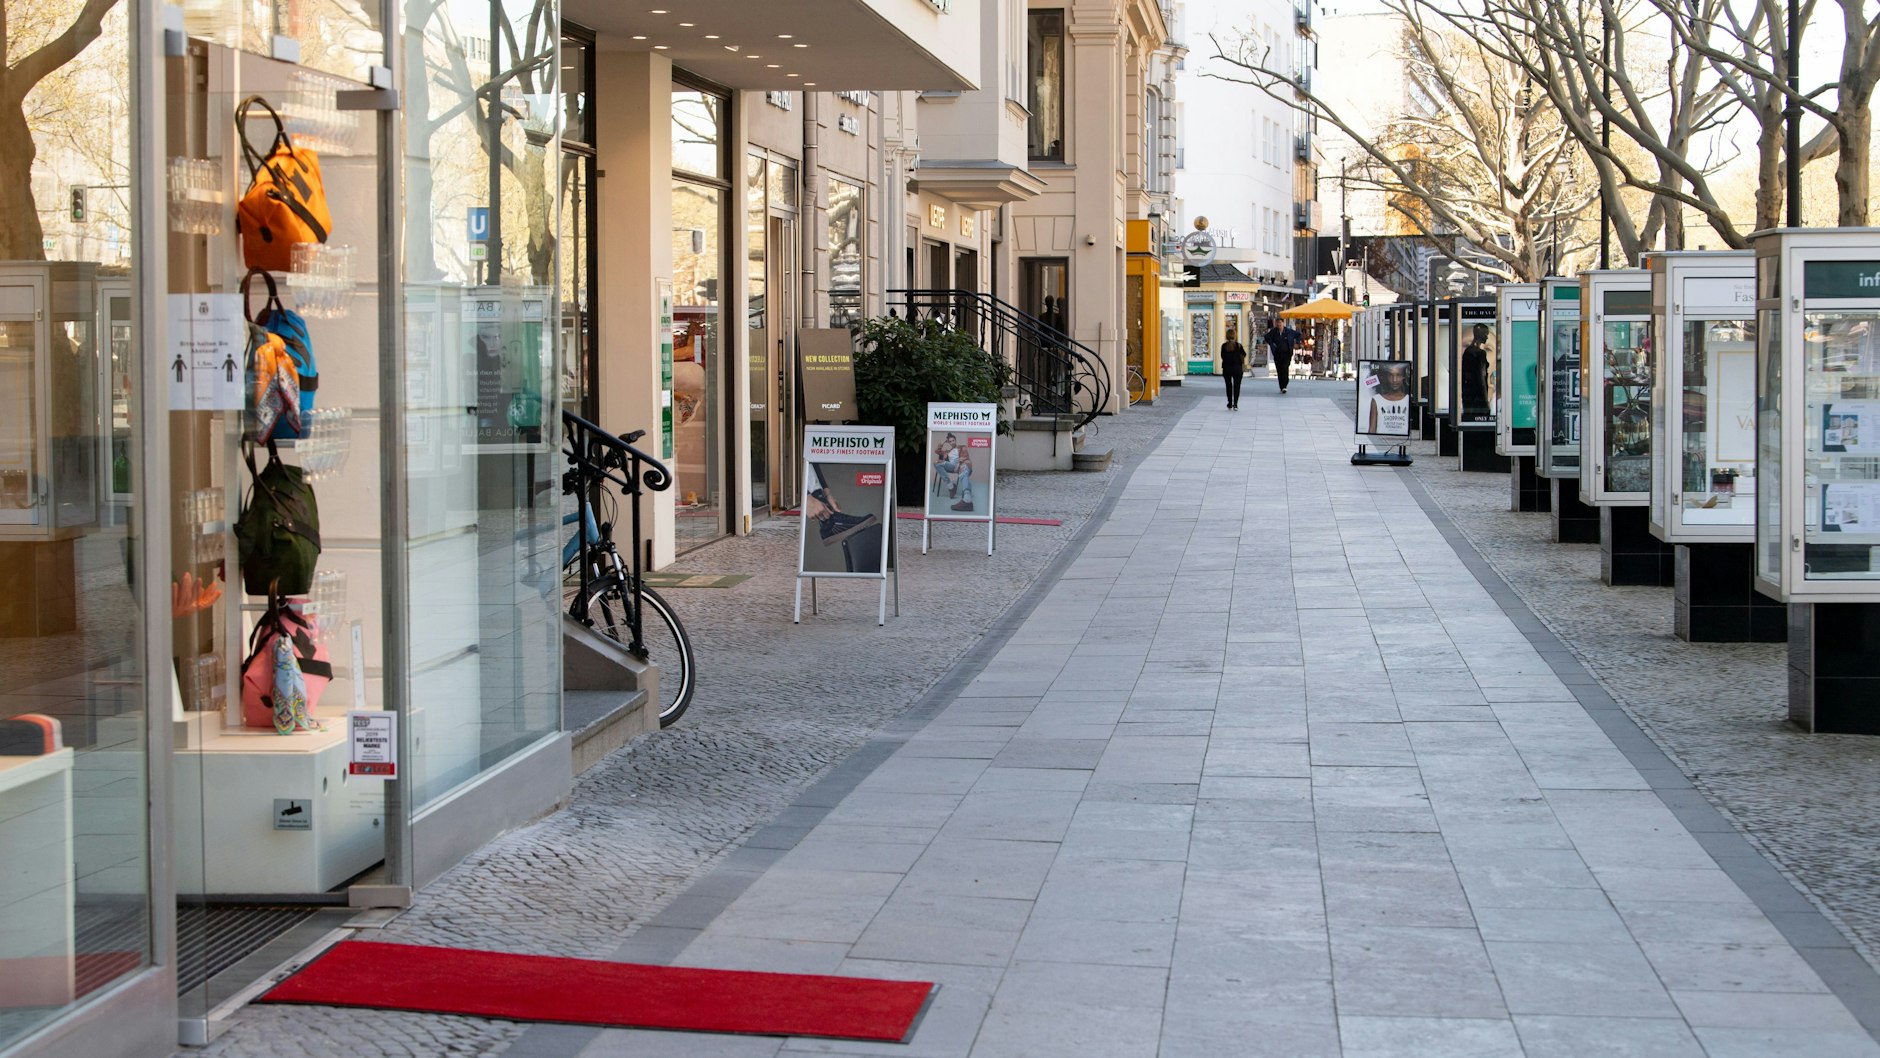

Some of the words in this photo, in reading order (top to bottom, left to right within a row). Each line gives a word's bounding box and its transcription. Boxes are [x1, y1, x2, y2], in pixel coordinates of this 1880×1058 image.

[805, 355, 817, 363] NEW
[818, 355, 850, 363] COLLECTION
[933, 411, 979, 421] MEPHISTO
[812, 436, 870, 448] MEPHISTO
